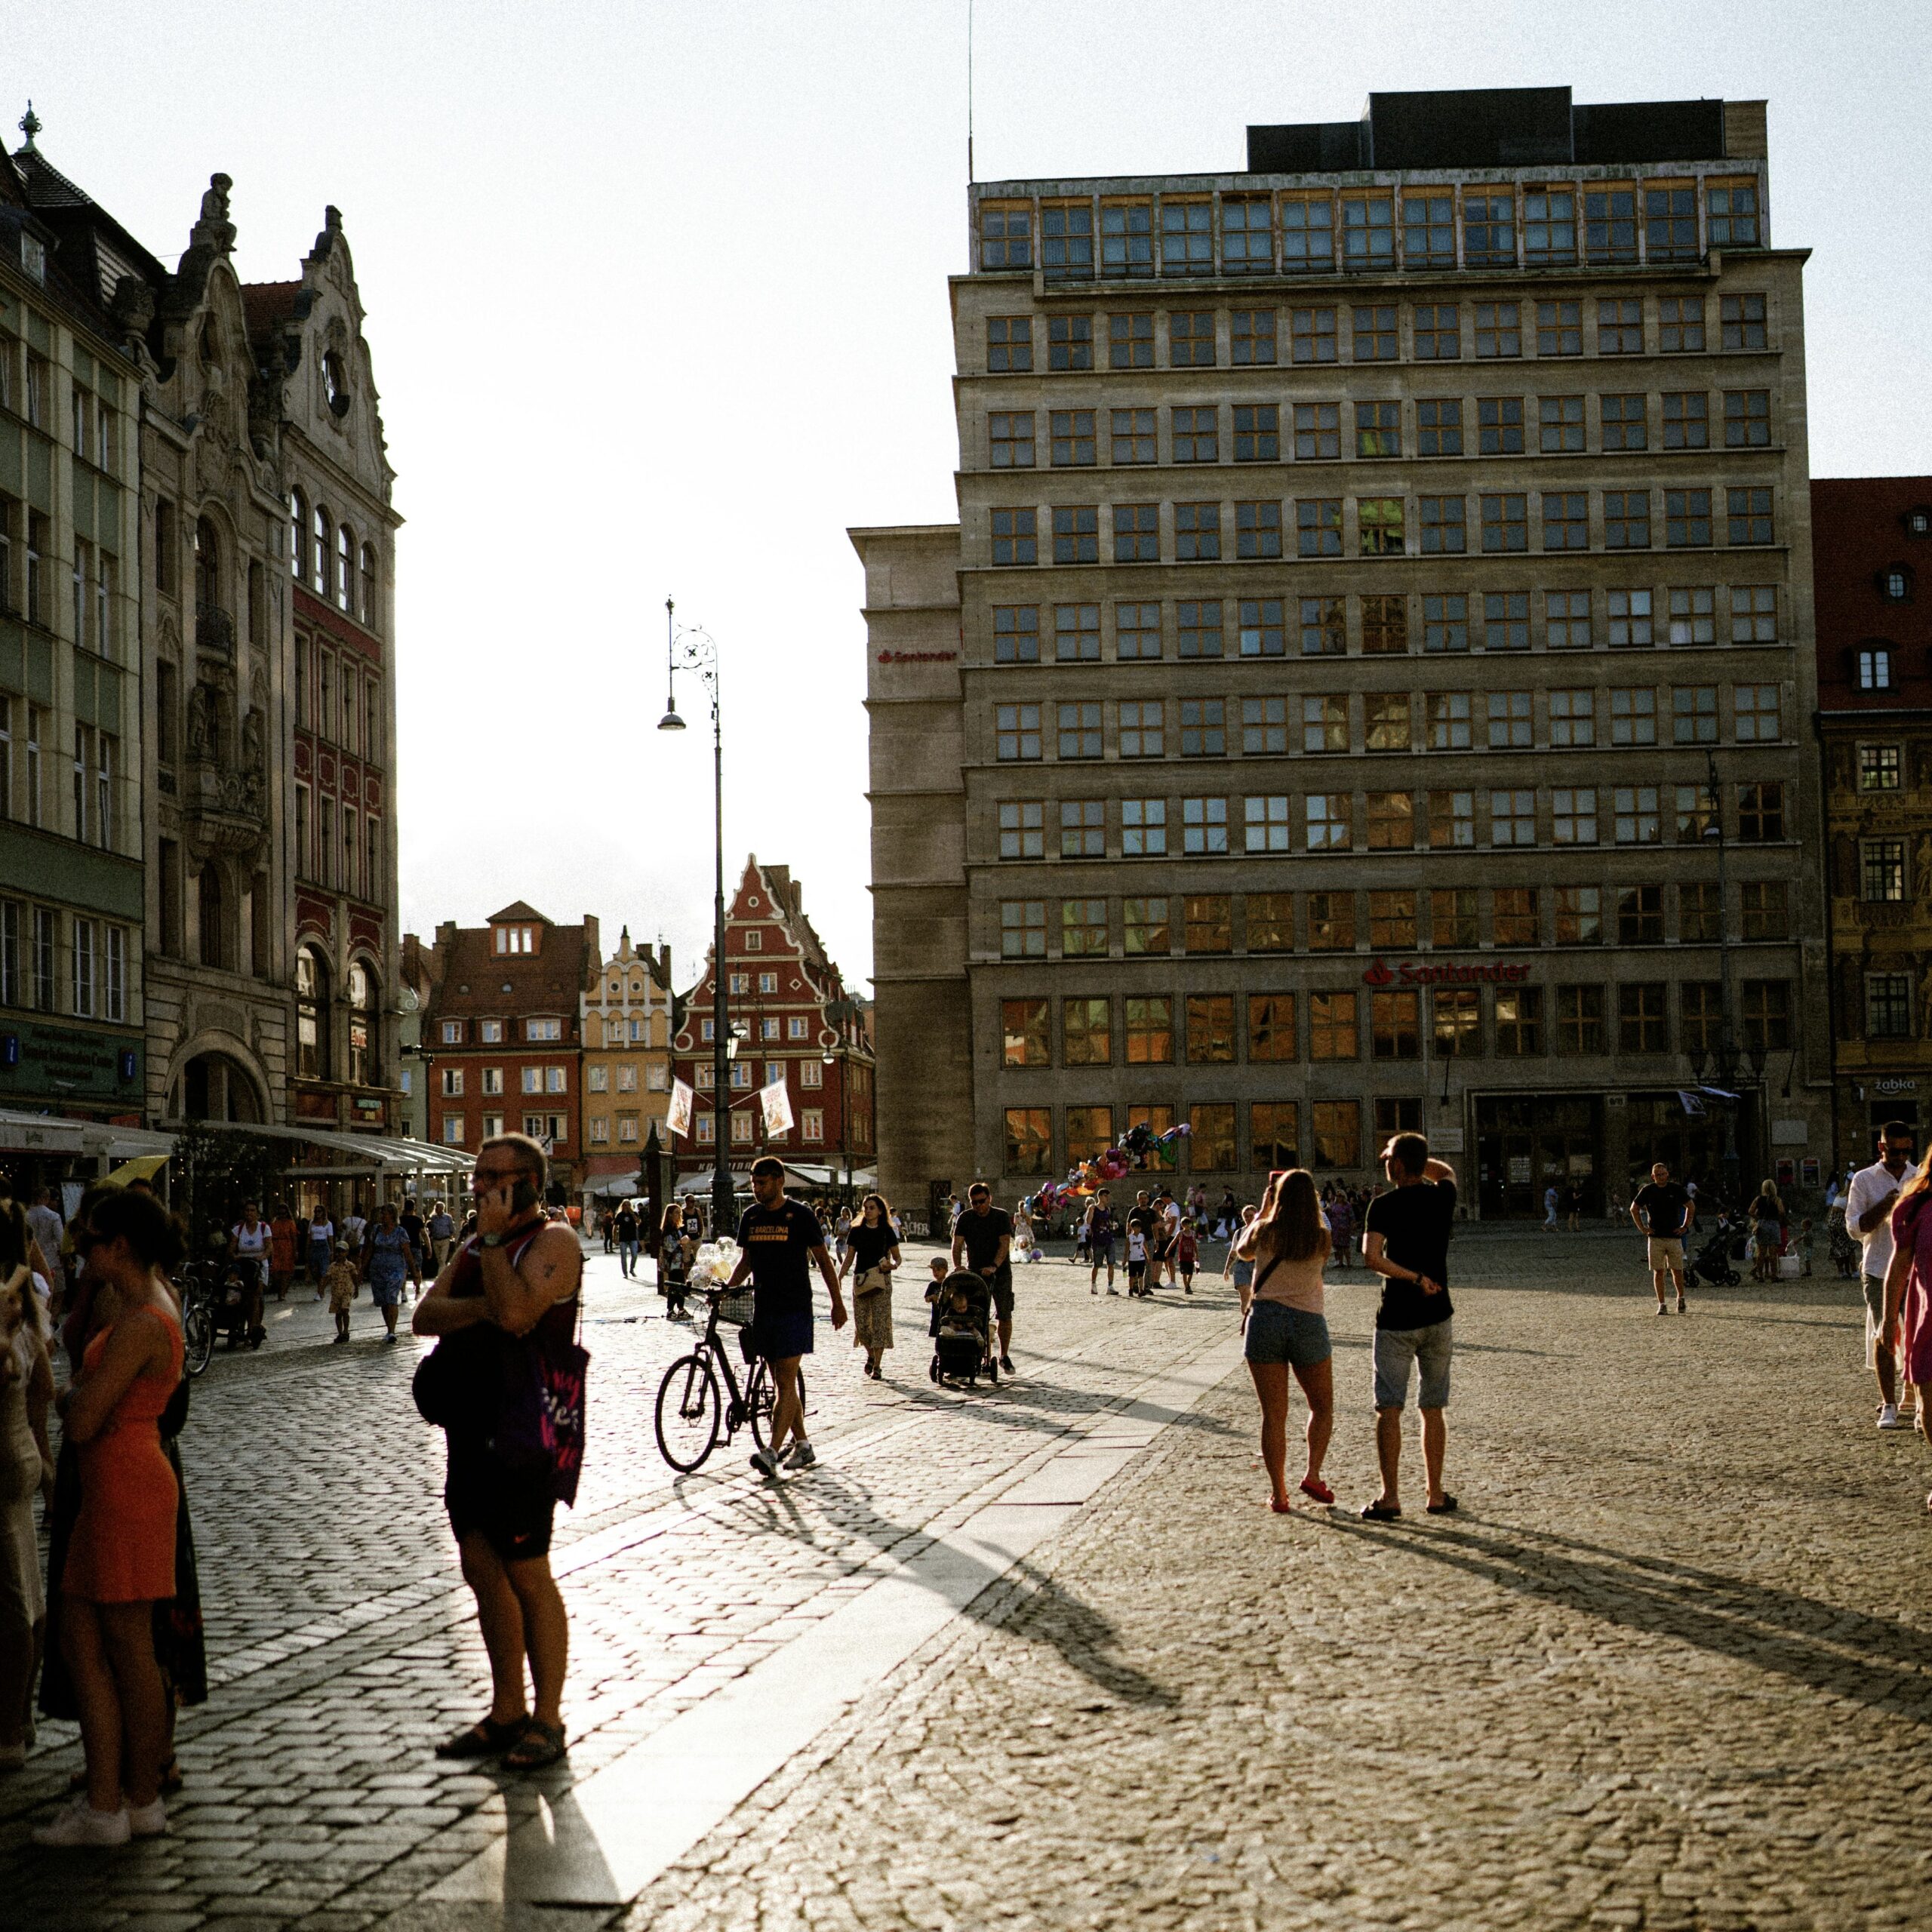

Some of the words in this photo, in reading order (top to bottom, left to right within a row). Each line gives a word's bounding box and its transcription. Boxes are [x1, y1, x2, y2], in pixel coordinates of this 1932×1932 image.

[894, 651, 957, 663] Santander
[1399, 960, 1531, 984] Santander
[1875, 1078, 1915, 1091] żabka
[755, 1226, 789, 1234] BARCELONA
